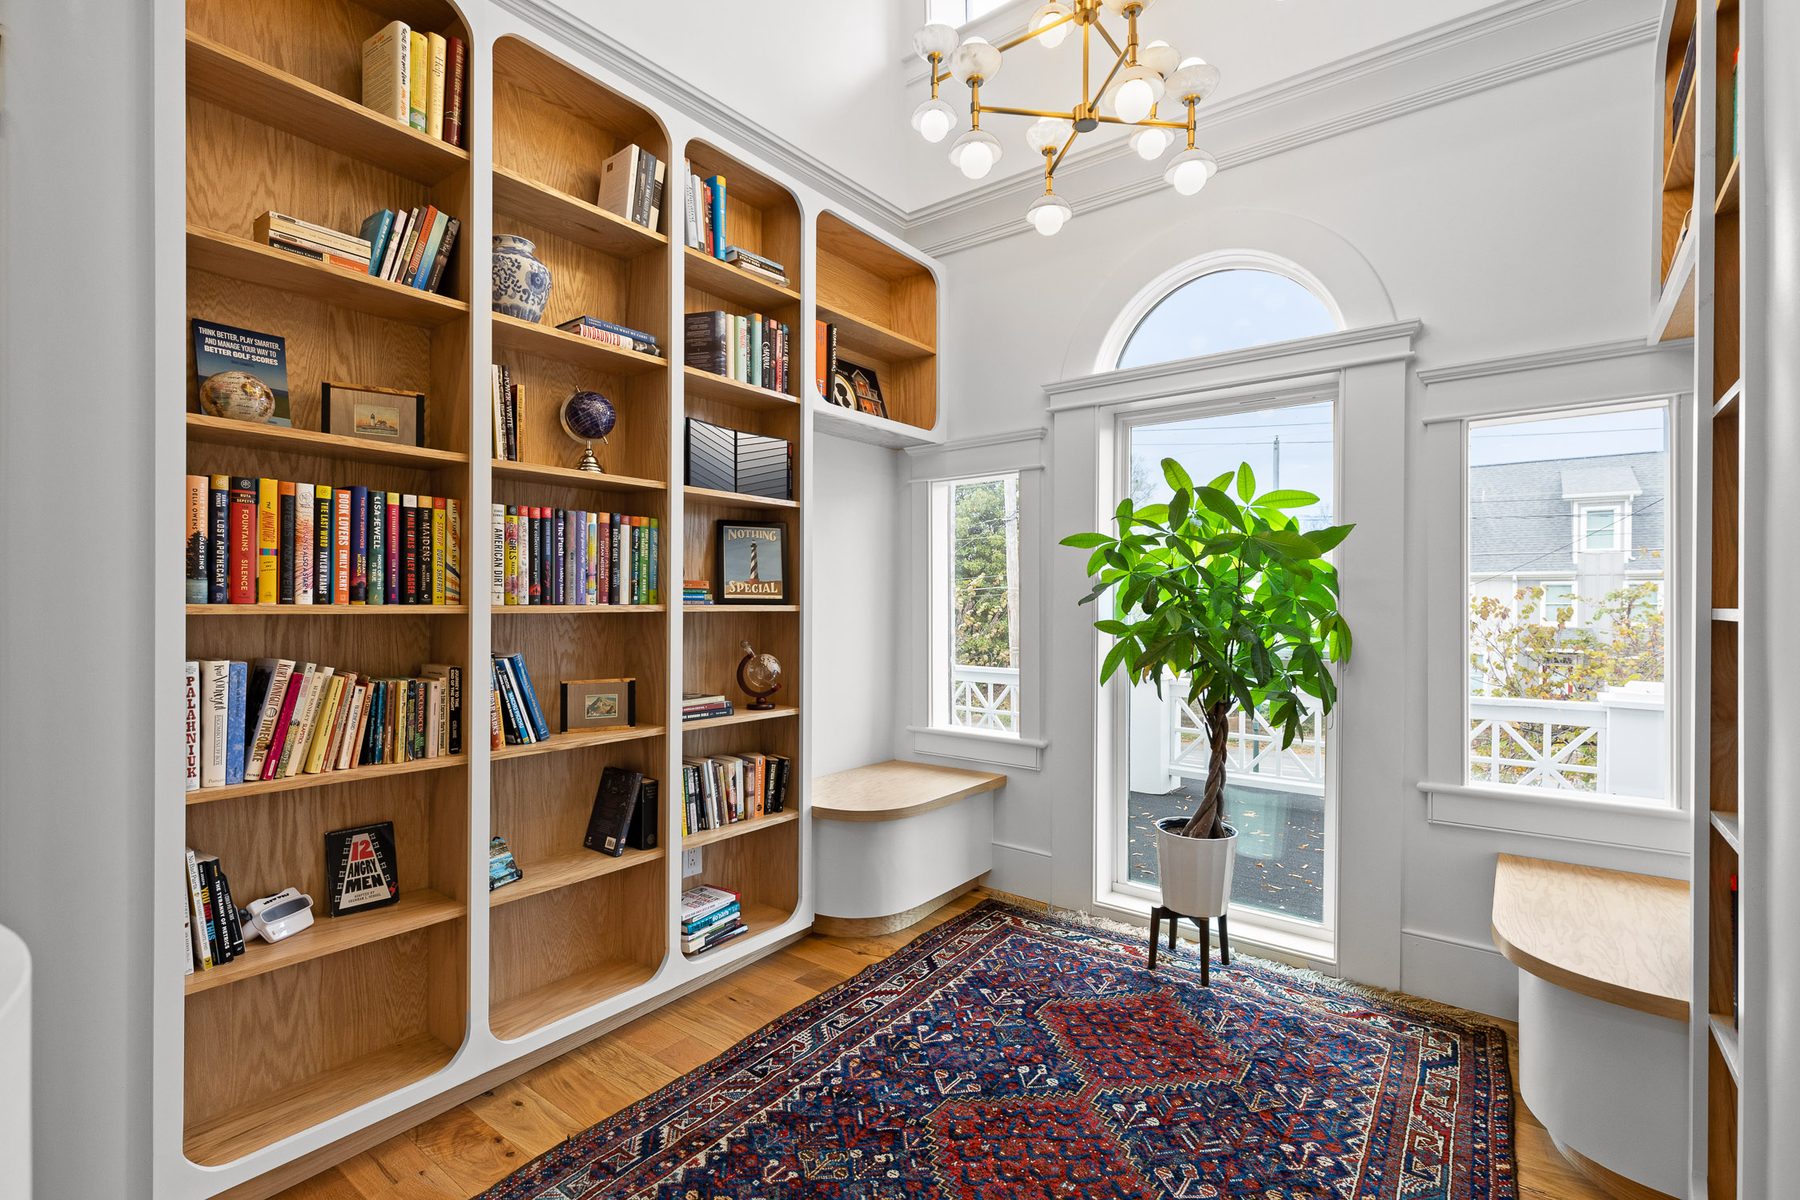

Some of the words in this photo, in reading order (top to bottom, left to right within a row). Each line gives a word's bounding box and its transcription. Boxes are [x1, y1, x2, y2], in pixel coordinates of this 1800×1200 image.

[433, 56, 443, 77] Help
[199, 327, 216, 336] THINK
[216, 331, 239, 341] BETTER,
[239, 336, 253, 344] PLAY
[254, 339, 280, 350] SMARTER,
[582, 326, 620, 346] UNDAUNTED
[204, 345, 232, 356] BETTER
[232, 352, 251, 360] GOLF
[251, 355, 278, 366] SCORES
[205, 338, 217, 346] AND
[217, 340, 240, 351] MANAGE
[241, 345, 256, 353] YOUR
[257, 348, 269, 356] WAY
[338, 493, 349, 515] BOOK
[373, 496, 381, 516] LISA
[262, 511, 276, 543] ANIMATORS
[338, 516, 349, 546] LOVERS
[605, 528, 609, 536] AS
[728, 529, 776, 542] NOTHING
[422, 522, 430, 562] MAIDENS
[452, 543, 456, 552] WE
[493, 528, 503, 568] AMERICAN
[509, 538, 517, 560] GIRLS
[216, 540, 224, 587] APOTHECARY
[319, 551, 327, 572] TAYLOR
[339, 549, 348, 568] EMILY
[319, 574, 327, 594] ADAMS
[339, 571, 348, 591] HENRY
[494, 570, 503, 587] DIRT
[729, 580, 778, 593] SPECIAL
[214, 664, 224, 677] Kurt
[274, 664, 291, 678] KURT
[268, 680, 287, 707] VONNEGUT
[304, 698, 316, 721] VONNEGUT
[350, 704, 359, 731] BLUEBEARD
[508, 692, 518, 711] MACHU
[514, 711, 524, 728] PICCHU
[186, 676, 197, 778] PALAHNIUK
[297, 723, 308, 744] SLAPSTICK
[252, 719, 274, 762] TIMEQUAKE
[188, 855, 194, 863] No
[351, 839, 374, 861] 12
[347, 858, 378, 879] ANGRY
[344, 874, 384, 894] MEN
[201, 886, 210, 904] YOU
[203, 904, 212, 921] GOT
[217, 892, 225, 918] TYRANNY
[221, 926, 230, 949] METRICS
[206, 921, 216, 942] THIS
